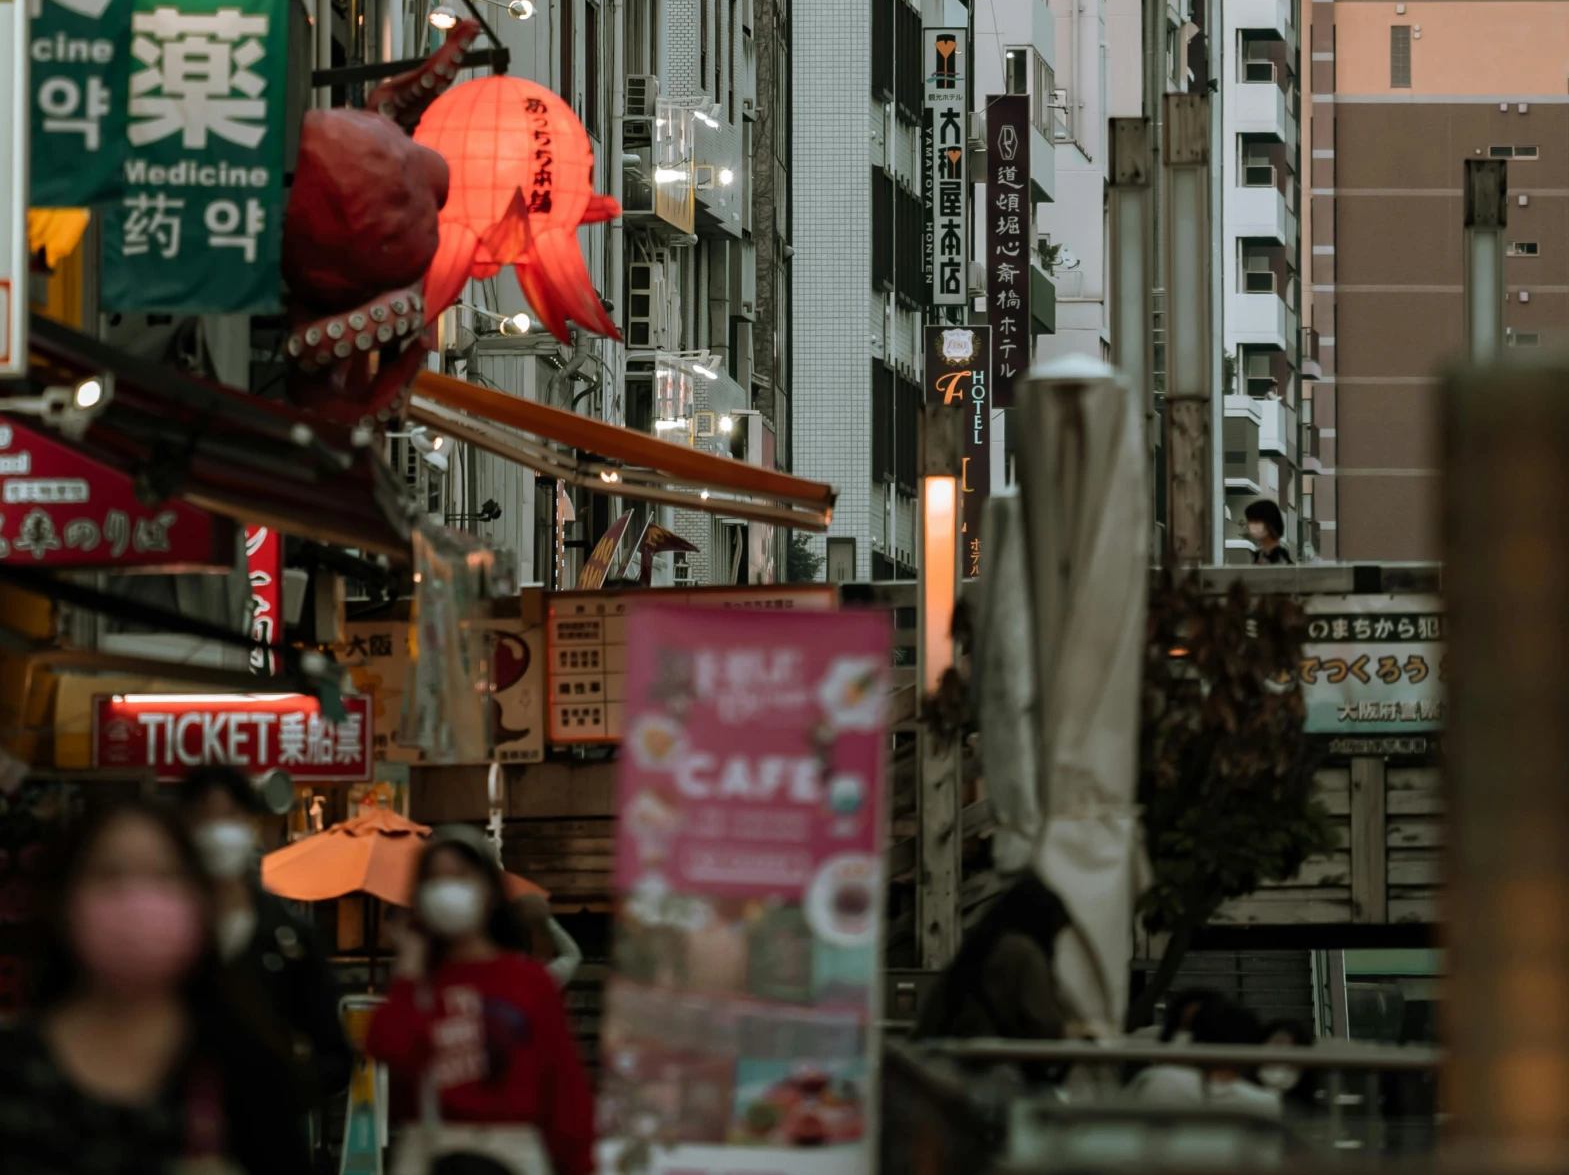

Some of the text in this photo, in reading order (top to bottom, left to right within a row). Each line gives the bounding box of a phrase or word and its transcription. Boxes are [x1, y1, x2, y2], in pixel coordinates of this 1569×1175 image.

[32, 32, 114, 64] cine
[127, 6, 269, 149] 薬
[38, 77, 111, 151] 약
[928, 93, 963, 101] 観光ホテル
[123, 160, 269, 188] Medicine
[925, 126, 933, 285] YAMATOYA HONTEN
[938, 107, 962, 295] 大和屋本店
[121, 193, 266, 263] 药 약
[971, 370, 986, 445] HOTEL
[970, 538, 982, 580] ホテル
[137, 711, 277, 766] TICKET
